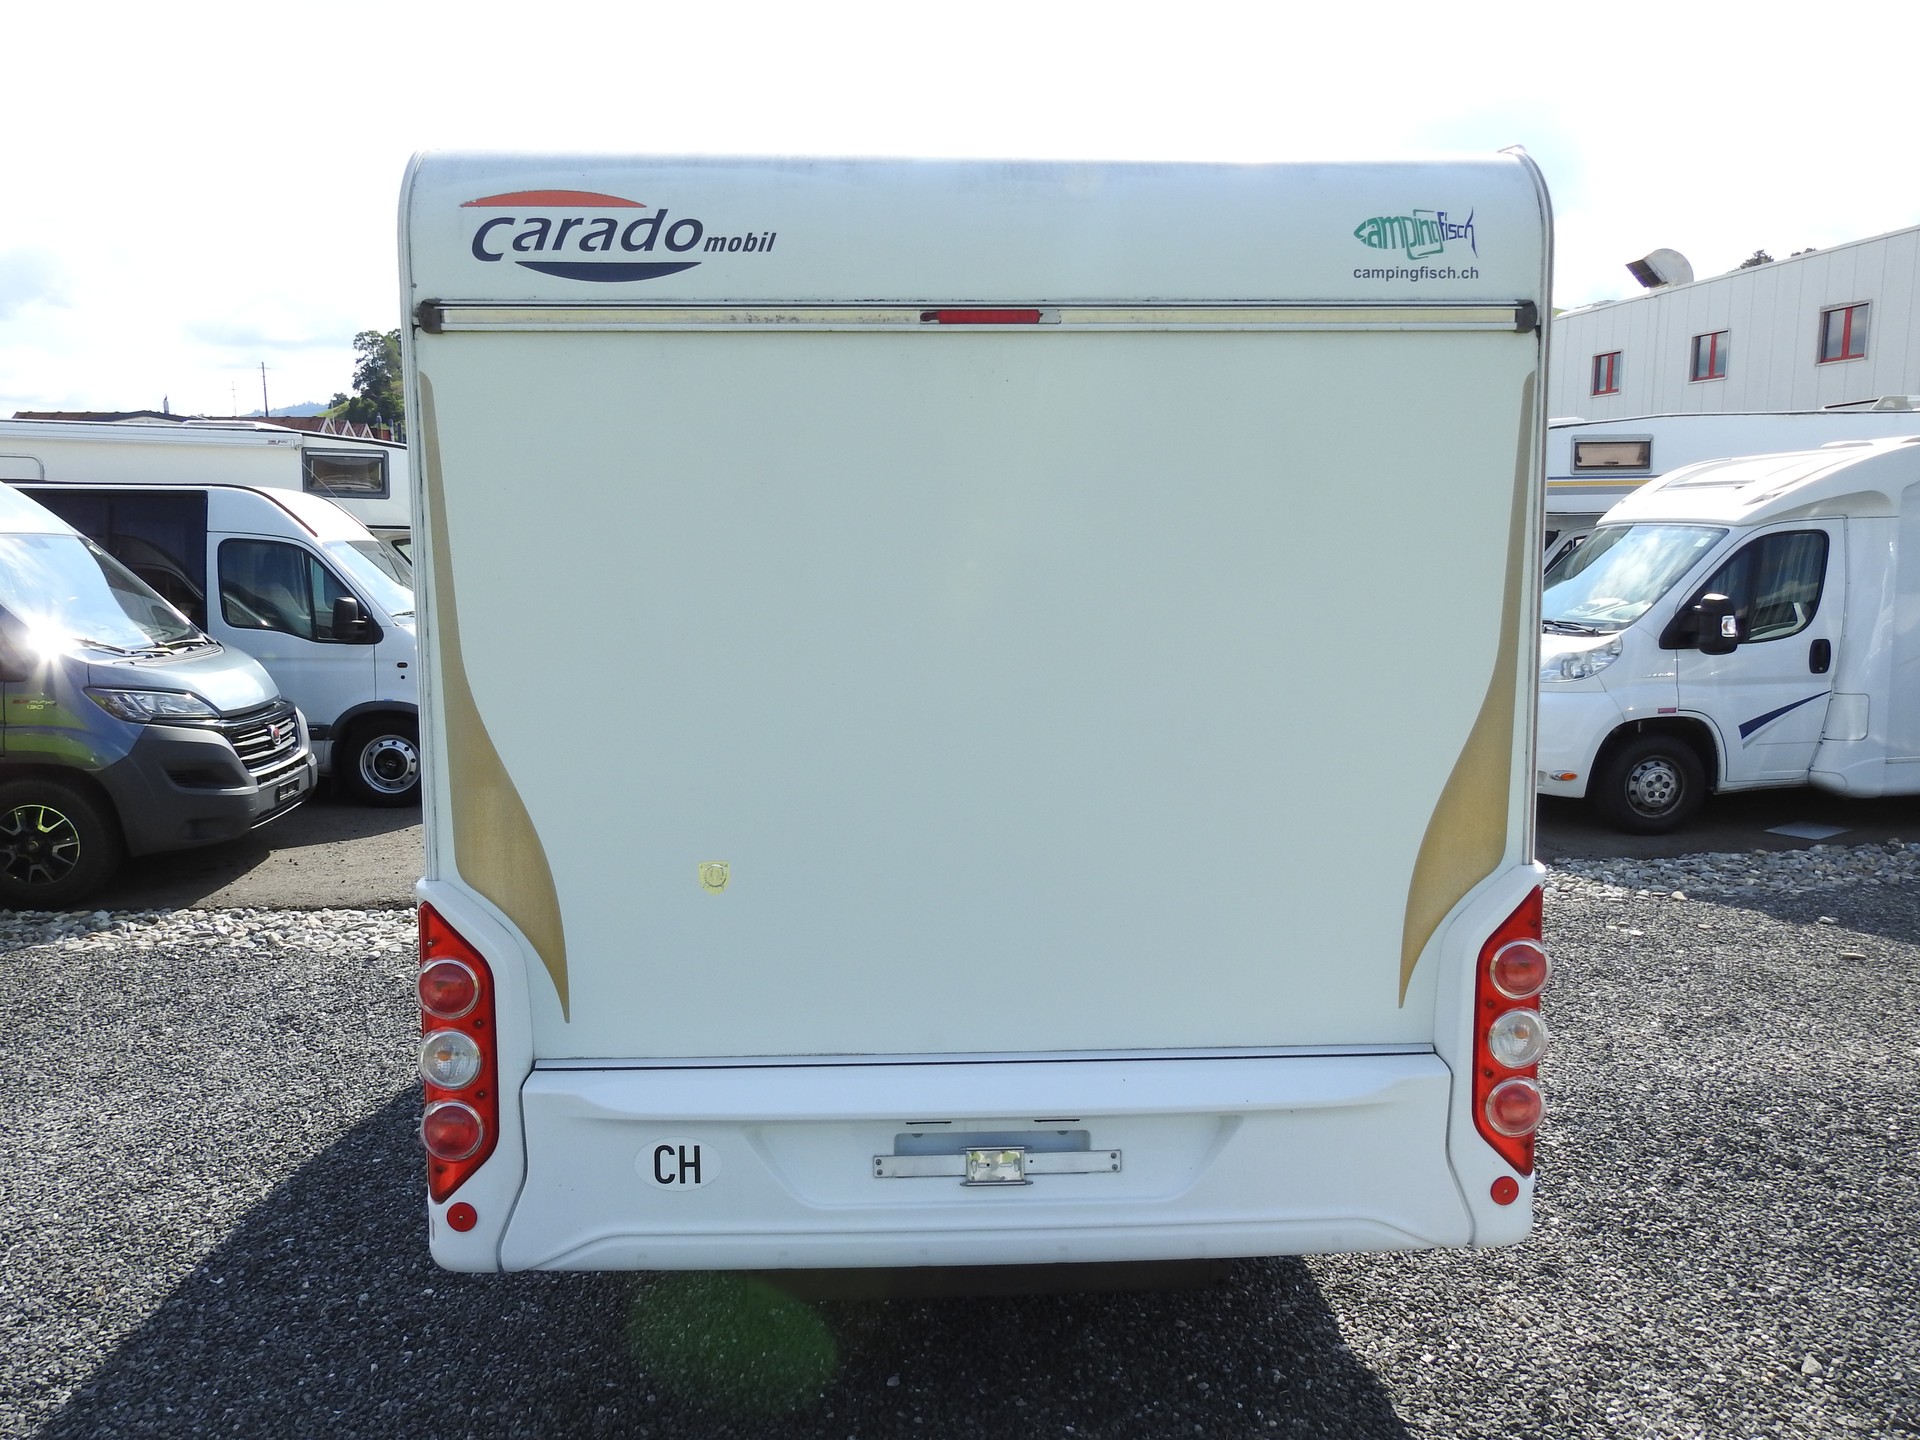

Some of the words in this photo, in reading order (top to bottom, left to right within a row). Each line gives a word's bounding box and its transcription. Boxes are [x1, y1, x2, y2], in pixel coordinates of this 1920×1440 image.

[703, 231, 777, 253] mobil
[1353, 266, 1479, 282] campingfisch.ch
[653, 1144, 701, 1184] CH
